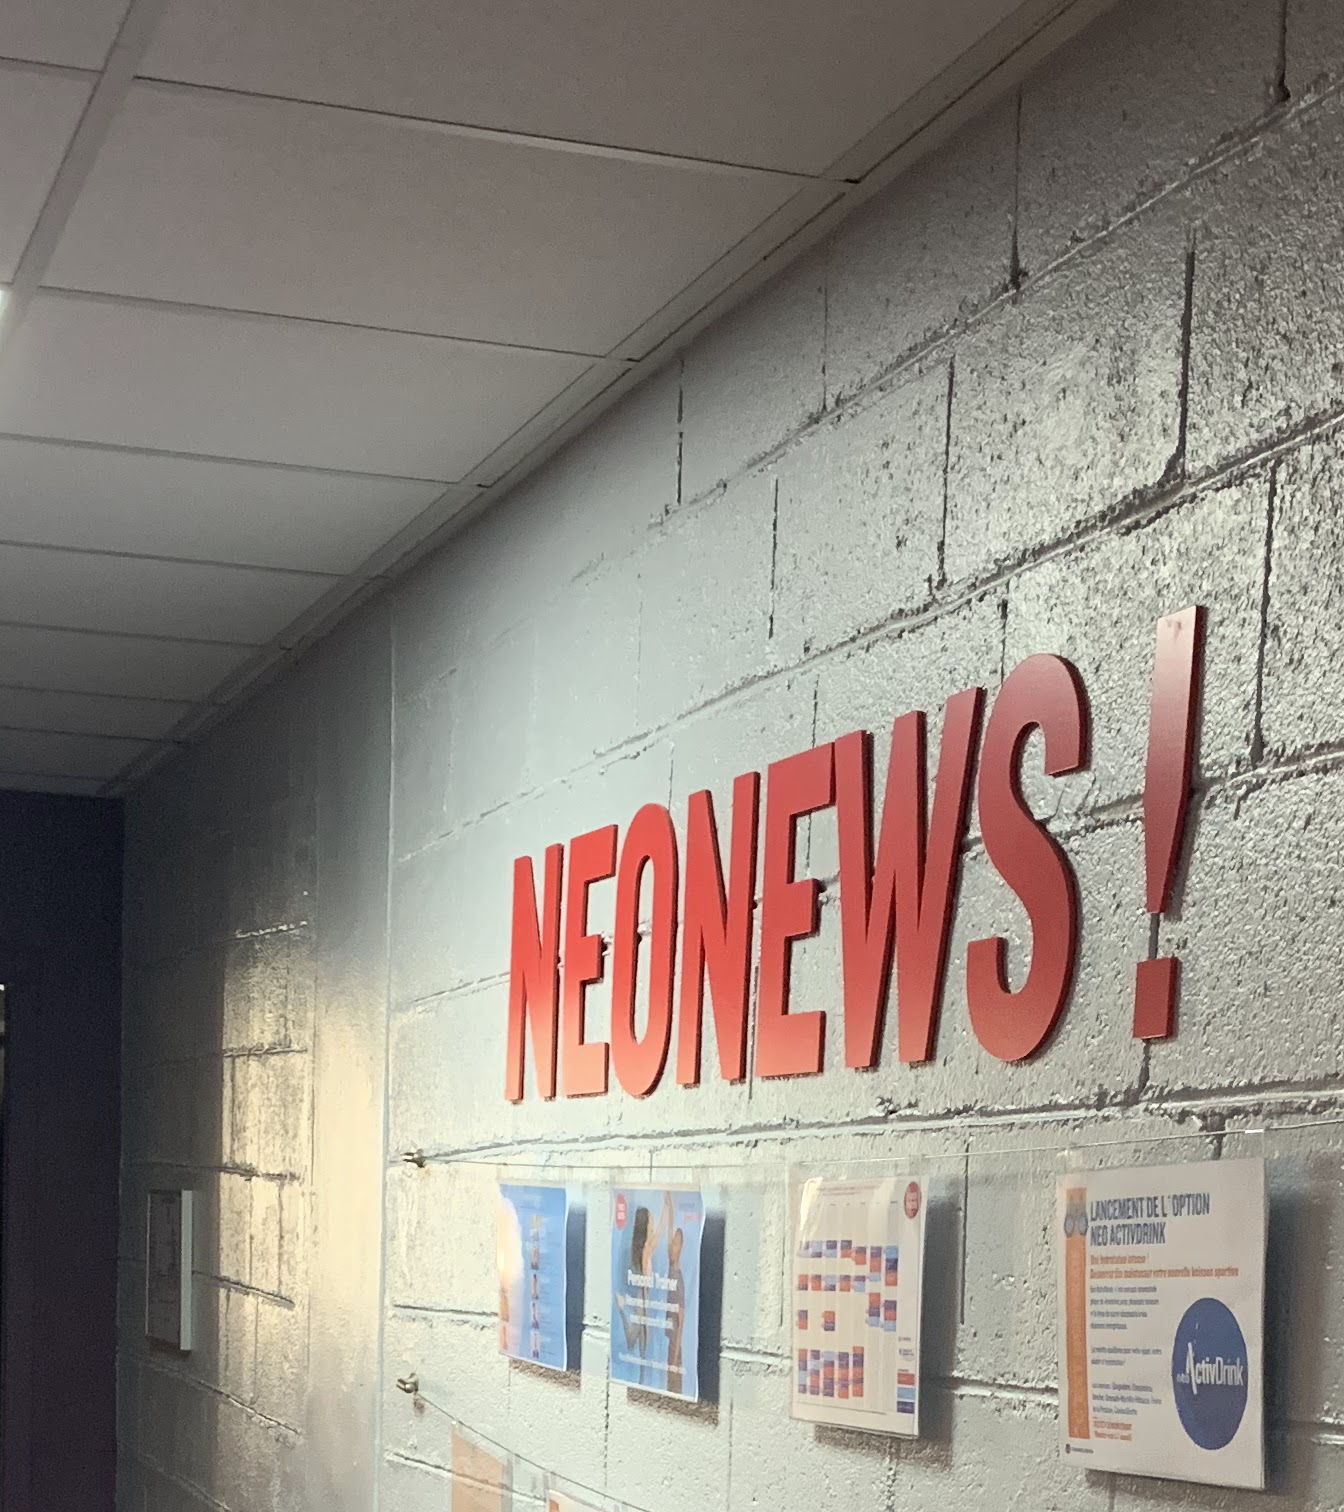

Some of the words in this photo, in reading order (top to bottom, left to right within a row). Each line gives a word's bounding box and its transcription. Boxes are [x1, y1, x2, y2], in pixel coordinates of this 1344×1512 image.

[505, 653, 1090, 1102] NEONEWS
[1133, 605, 1204, 1040] !
[1090, 1196, 1145, 1222] LANCEMENT
[1146, 1196, 1159, 1218] DE
[1090, 1224, 1108, 1246] NEO
[1109, 1222, 1166, 1246] ACTIVDRINK
